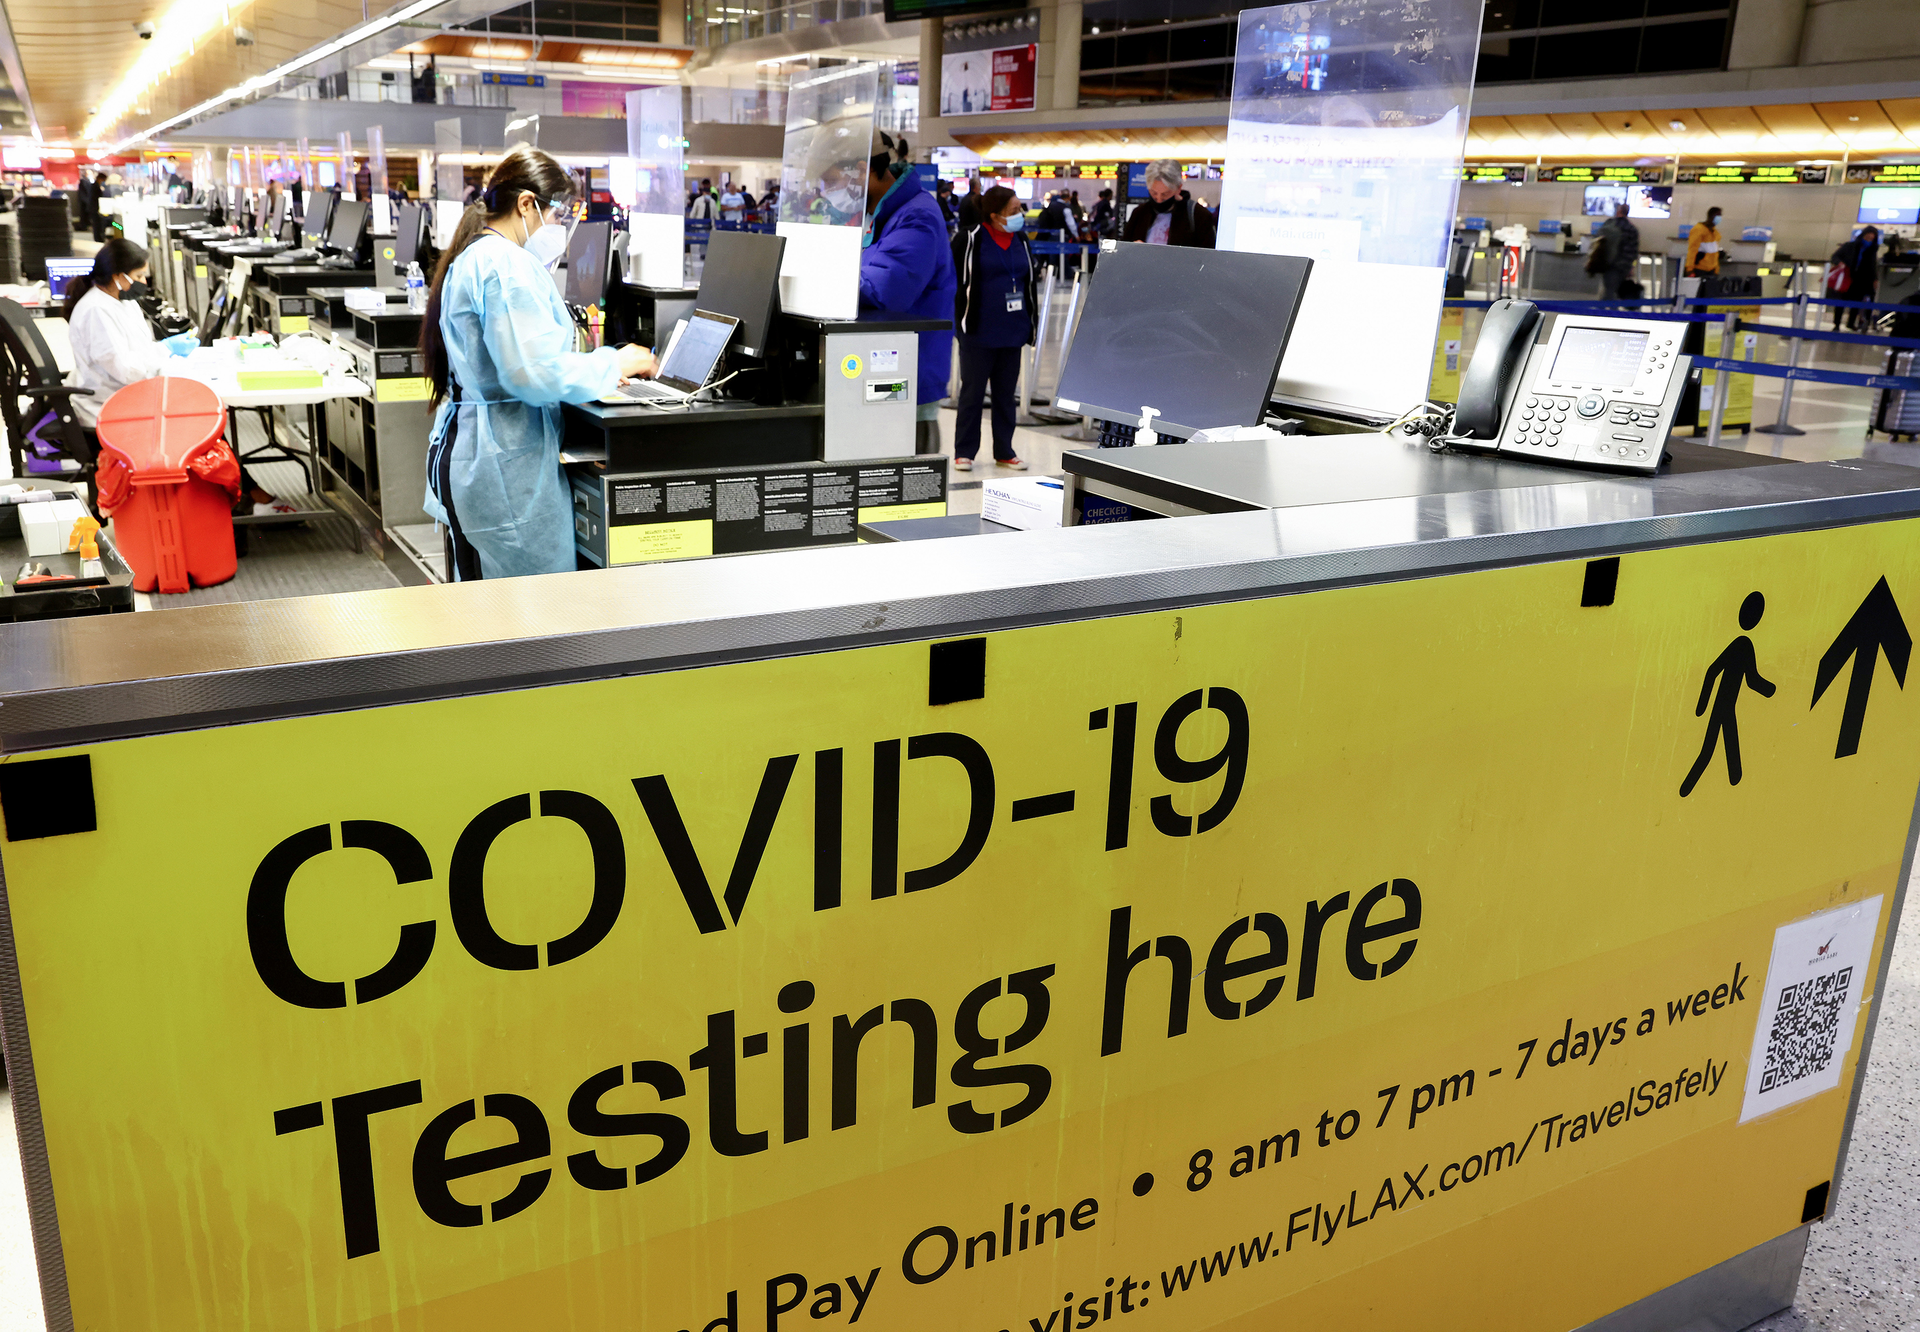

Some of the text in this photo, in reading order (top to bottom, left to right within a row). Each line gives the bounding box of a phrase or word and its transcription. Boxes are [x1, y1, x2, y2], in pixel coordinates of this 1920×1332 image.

[1087, 506, 1128, 518] CHECKED
[246, 686, 1250, 1010] COVID-19
[274, 878, 1422, 1260] Testing here
[766, 1266, 882, 1332] Pay
[901, 1197, 1099, 1285] Online
[1187, 1149, 1214, 1192] 8
[1230, 1128, 1301, 1178] am
[1316, 1109, 1361, 1148] to
[1375, 1084, 1401, 1129] 7
[1408, 1069, 1475, 1130] pm
[1489, 1067, 1502, 1078] -
[1515, 1038, 1539, 1080] 7
[1546, 1017, 1628, 1068] days
[1636, 1008, 1655, 1037] a
[1667, 961, 1749, 1026] week
[1028, 1058, 1729, 1332] visit: www.FlyLAX.com/TravelSafely
